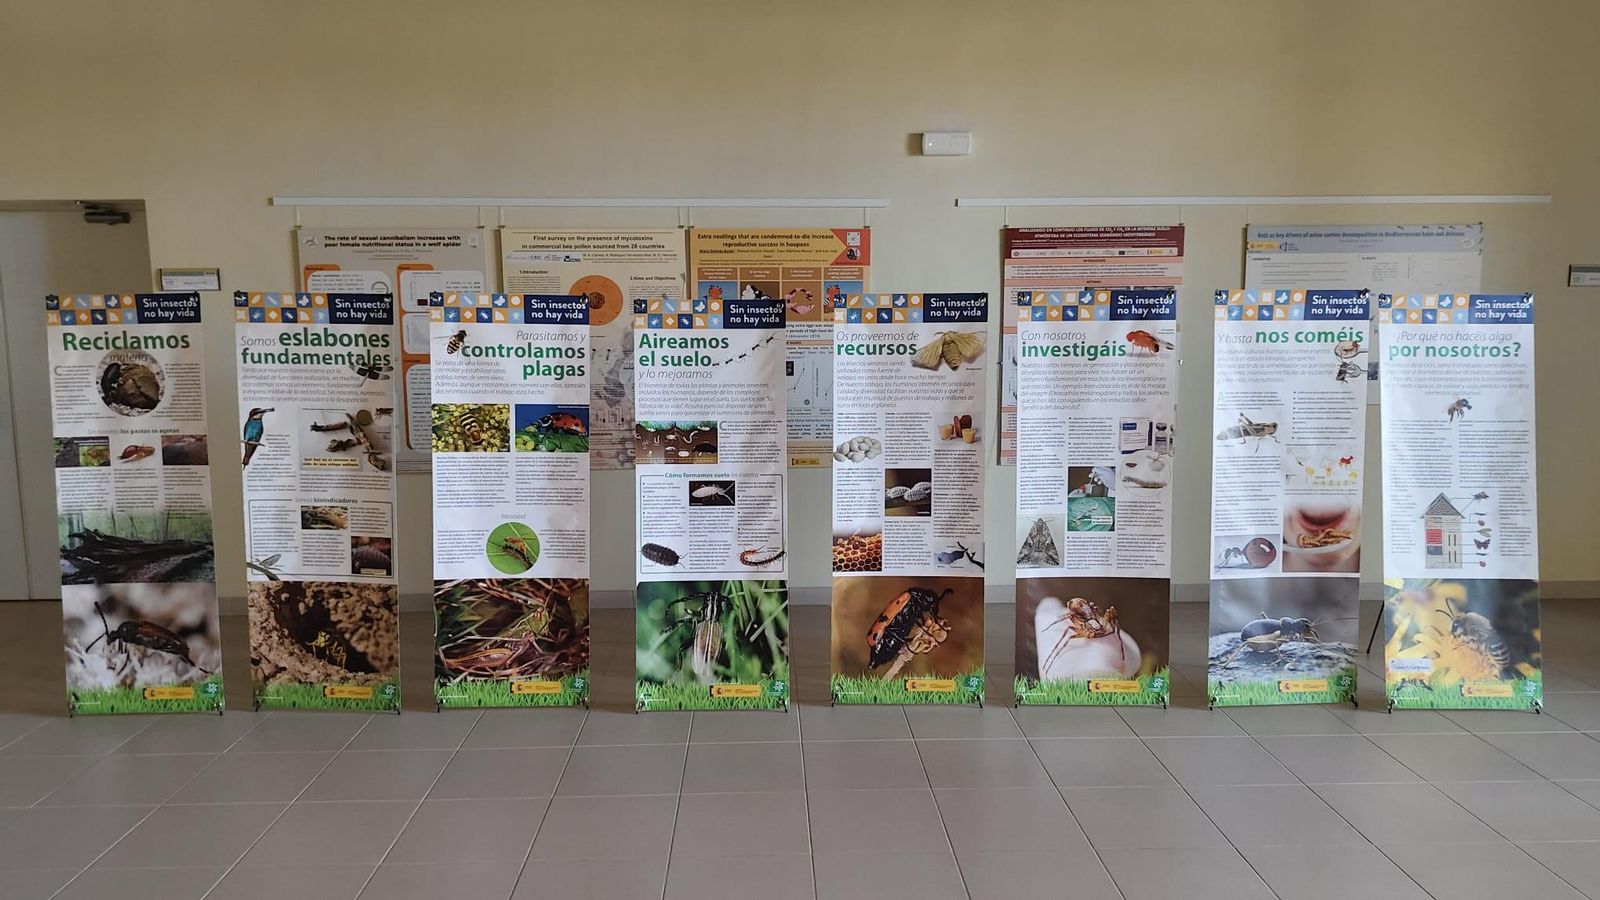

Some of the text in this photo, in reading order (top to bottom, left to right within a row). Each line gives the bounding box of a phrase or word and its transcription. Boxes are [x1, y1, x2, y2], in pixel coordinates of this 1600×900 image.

[143, 298, 198, 308] Sin insectos
[335, 298, 390, 309] Sin insectos
[531, 299, 587, 309] Sin insectos
[931, 298, 985, 307] Sin insectos
[1118, 295, 1174, 304] Sin insectos
[1313, 295, 1367, 305] Sin insectos
[1476, 300, 1530, 309] Sin insectos
[158, 308, 174, 320] hay
[176, 308, 195, 317] vida
[350, 309, 367, 321] hay
[370, 309, 387, 319] vida
[730, 304, 783, 314] Sin insectos
[944, 308, 960, 319] hay
[963, 308, 981, 317] vida
[1131, 305, 1148, 317] hay
[1151, 305, 1170, 315] vida
[1325, 305, 1342, 317] hay
[1345, 305, 1363, 314] vida
[1488, 309, 1505, 320] hay
[1508, 309, 1527, 319] vida
[545, 310, 562, 321] hay
[565, 310, 583, 319] vida
[744, 314, 759, 325] hay
[762, 314, 779, 323] vida
[63, 331, 190, 350] Reciclamos
[240, 327, 390, 348] Somos eslabones
[516, 330, 586, 344] Parasitamos y
[639, 333, 728, 349] Aireamos
[836, 330, 919, 342] Os proveemos de
[1021, 330, 1086, 341] Con nosotros
[1219, 327, 1363, 344] Y hasta nos coméis
[1397, 331, 1513, 343] ¿Por qué no hacéis algo
[461, 342, 585, 359] controlamos
[837, 344, 917, 355] recursos
[1022, 341, 1126, 361] investigáis
[1389, 342, 1521, 360] por nosotros?
[110, 352, 148, 362] materia
[241, 347, 391, 366] fundamentales
[639, 351, 711, 367] el suelo
[523, 361, 585, 380] plagas
[638, 369, 712, 380] y lo mejoramos
